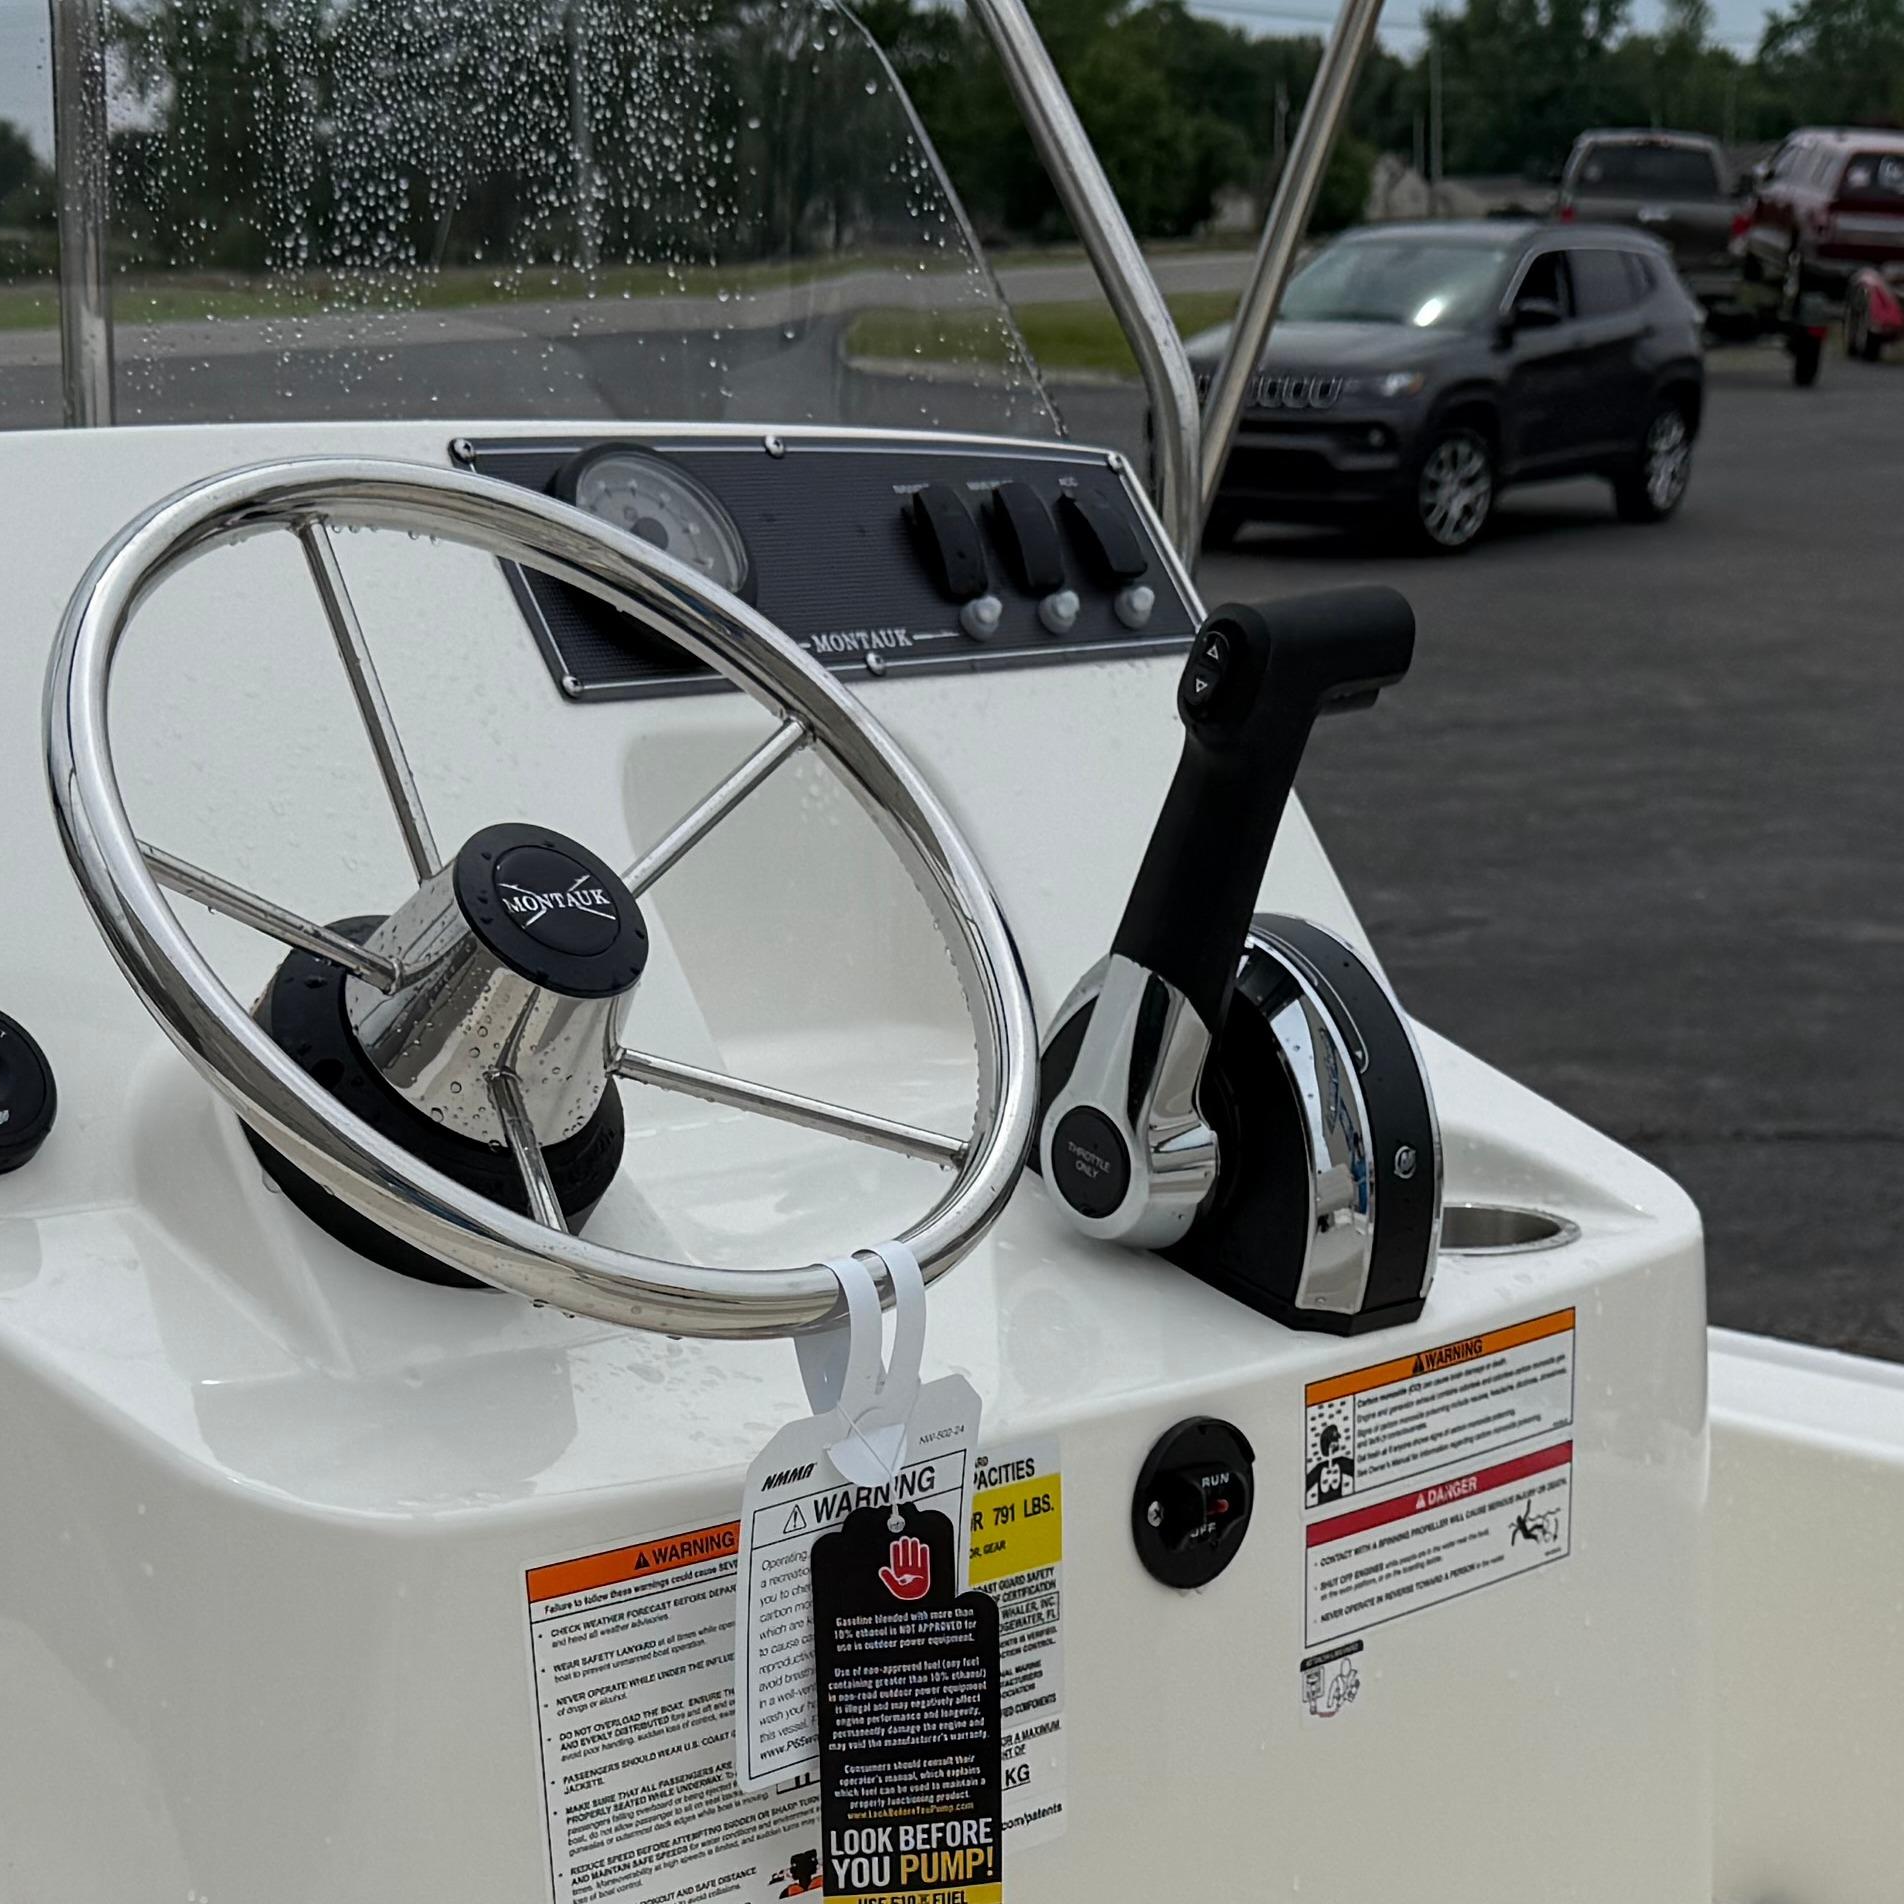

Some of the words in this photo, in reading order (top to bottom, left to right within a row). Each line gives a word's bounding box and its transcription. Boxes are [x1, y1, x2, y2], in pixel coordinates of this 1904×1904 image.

[811, 627, 913, 655] MONTAUK
[502, 888, 611, 913] MONTAUK
[1068, 1141, 1110, 1174] THROTTLE
[1076, 1160, 1100, 1178] ONLY
[1423, 1337, 1483, 1370] WARNING
[760, 1462, 818, 1492] NMMA
[1201, 1472, 1230, 1488] RUN
[1426, 1474, 1477, 1507] DANGER
[992, 1503, 1015, 1526] 791
[1023, 1493, 1054, 1518] LBS.
[652, 1529, 735, 1566] WARNING
[761, 1550, 808, 1571] Operating
[983, 1540, 1006, 1555] GEAR
[543, 1599, 573, 1616] Failure
[573, 1597, 583, 1608] to
[583, 1590, 609, 1606] follow
[609, 1584, 632, 1599] these
[633, 1575, 670, 1595] warnings
[670, 1570, 693, 1585] could
[693, 1565, 717, 1579] cause
[998, 1574, 1025, 1590] GUARD
[1026, 1567, 1055, 1582] SAFETY
[1001, 1579, 1056, 1603] CERTIFICATION
[550, 1623, 581, 1639] CHECK
[582, 1611, 625, 1630] WEATHER
[626, 1599, 672, 1619] FORECAST
[673, 1591, 706, 1607] BEFORE
[834, 1628, 853, 1640] 10%
[854, 1625, 887, 1639] ethanol
[889, 1624, 897, 1636] is
[898, 1623, 915, 1635] NOT
[917, 1619, 962, 1634] APPROVED
[964, 1618, 976, 1630] for
[835, 1614, 872, 1627] Gasoline
[874, 1611, 908, 1624] blended
[910, 1609, 928, 1621] with
[929, 1609, 952, 1620] more
[954, 1606, 974, 1618] than
[836, 1642, 852, 1652] use
[854, 1640, 862, 1652] in
[863, 1637, 898, 1651] outdoor
[899, 1637, 925, 1648] power
[927, 1631, 975, 1646] equipment.
[555, 1691, 586, 1707] NEVER
[588, 1680, 627, 1699] OPERATE
[628, 1673, 655, 1688] WHILE
[657, 1664, 686, 1680] UNDER
[687, 1659, 704, 1672] THE
[828, 1677, 873, 1692] containing
[874, 1674, 906, 1688] greater
[908, 1672, 928, 1685] than
[930, 1671, 949, 1684] 10%
[951, 1668, 986, 1682] ethanol)
[558, 1730, 573, 1743] DO
[574, 1725, 592, 1738] NOT
[592, 1712, 641, 1733] OVERLOAD
[642, 1707, 659, 1720] THE
[562, 1761, 620, 1786] PASSENGERS
[621, 1751, 656, 1769] SHOULD
[657, 1743, 682, 1759] WEAR
[700, 1730, 729, 1746] COAST
[1005, 1763, 1030, 1787] KG
[829, 1825, 893, 1857] LOOK
[898, 1817, 993, 1852] BEFORE
[675, 1885, 694, 1899] AND
[695, 1878, 716, 1893] SAFE
[717, 1865, 757, 1886] DISTANCE
[831, 1853, 891, 1890] YOU
[899, 1845, 993, 1885] PUMP!
